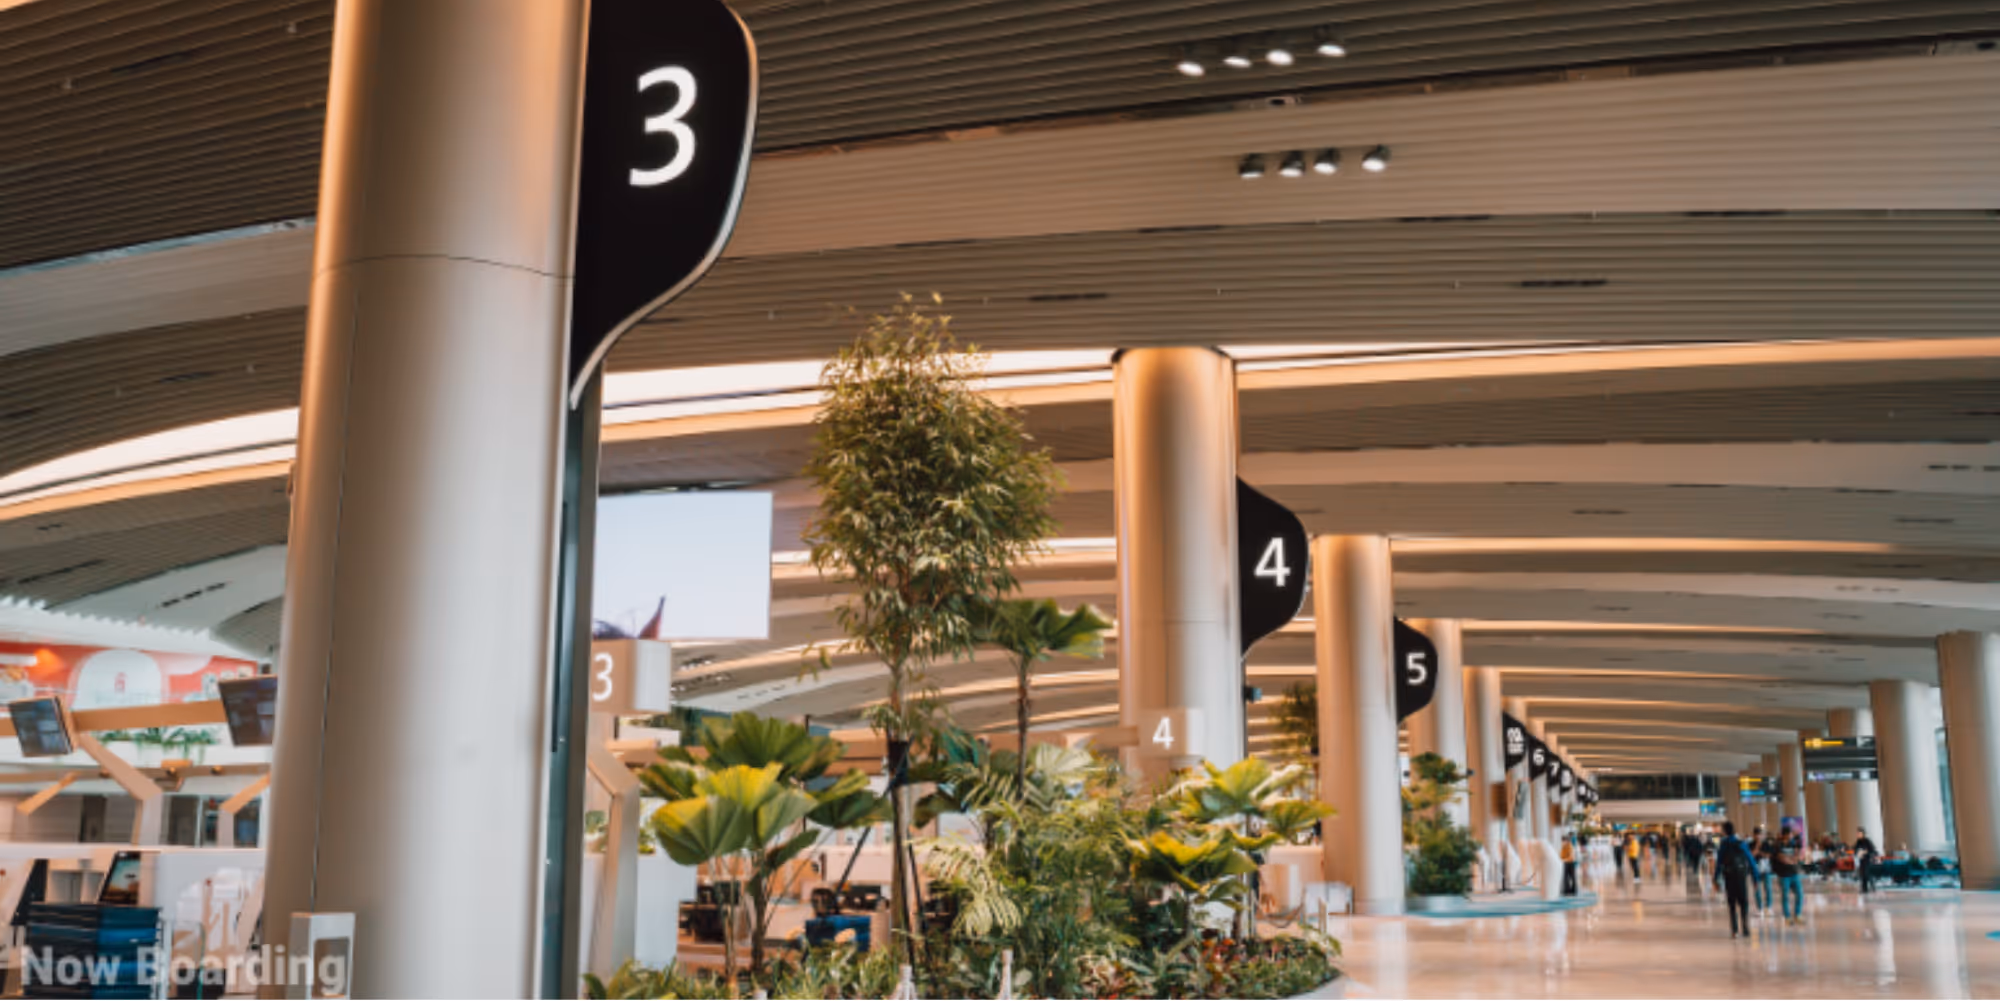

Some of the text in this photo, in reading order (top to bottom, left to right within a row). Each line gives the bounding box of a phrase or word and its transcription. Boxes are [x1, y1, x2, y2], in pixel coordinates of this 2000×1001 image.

[628, 66, 698, 188] 3
[1254, 537, 1290, 587] 4
[592, 652, 613, 701] 3
[1406, 652, 1427, 684] 5
[1152, 717, 1174, 749] 4
[1532, 749, 1544, 766] 6
